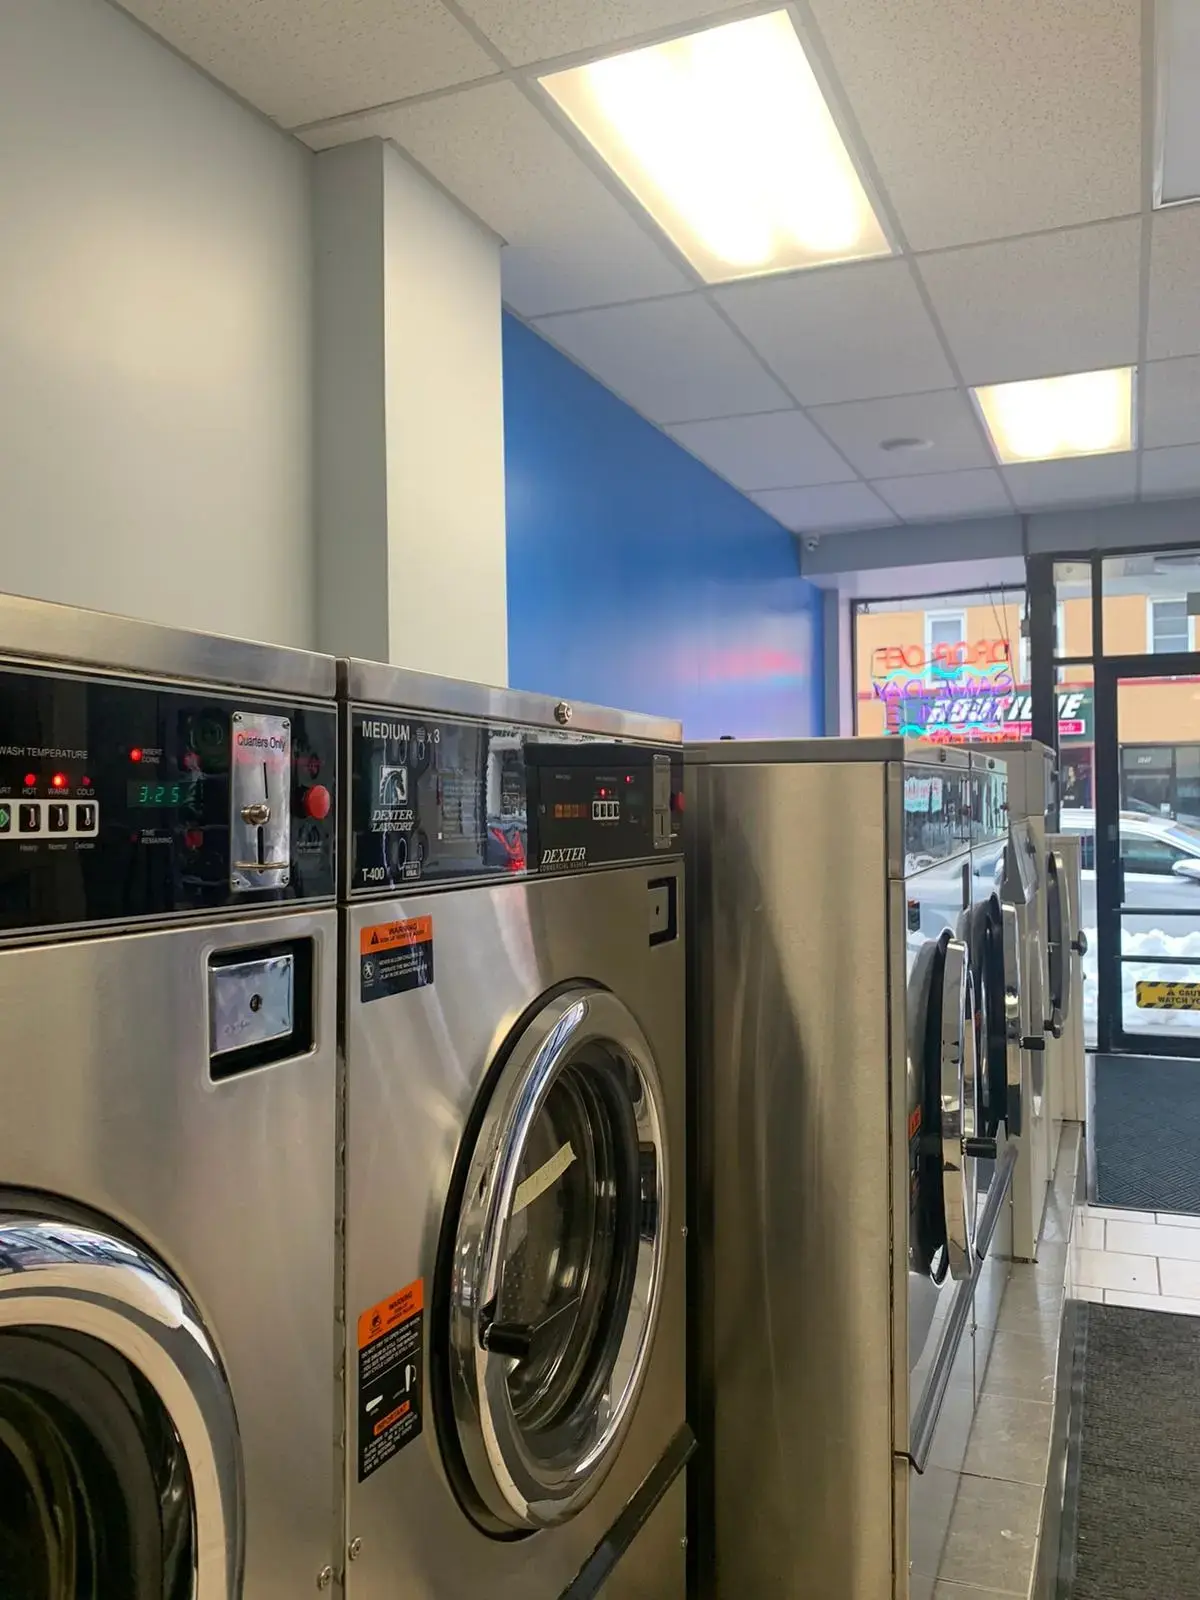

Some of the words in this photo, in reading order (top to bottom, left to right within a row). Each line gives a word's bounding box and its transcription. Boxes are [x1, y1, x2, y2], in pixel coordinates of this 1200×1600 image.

[362, 721, 410, 741] MEDIUM
[434, 729, 440, 744] 3
[237, 734, 268, 749] Quarters
[270, 737, 286, 751] Only
[0, 746, 25, 756] WASH
[26, 747, 88, 759] TEMPERATURE
[76, 788, 94, 796] COLD
[372, 809, 413, 821] DEXTER
[372, 821, 414, 832] LAUNDRY
[541, 847, 586, 865] DEXTER
[362, 867, 385, 881] T-400
